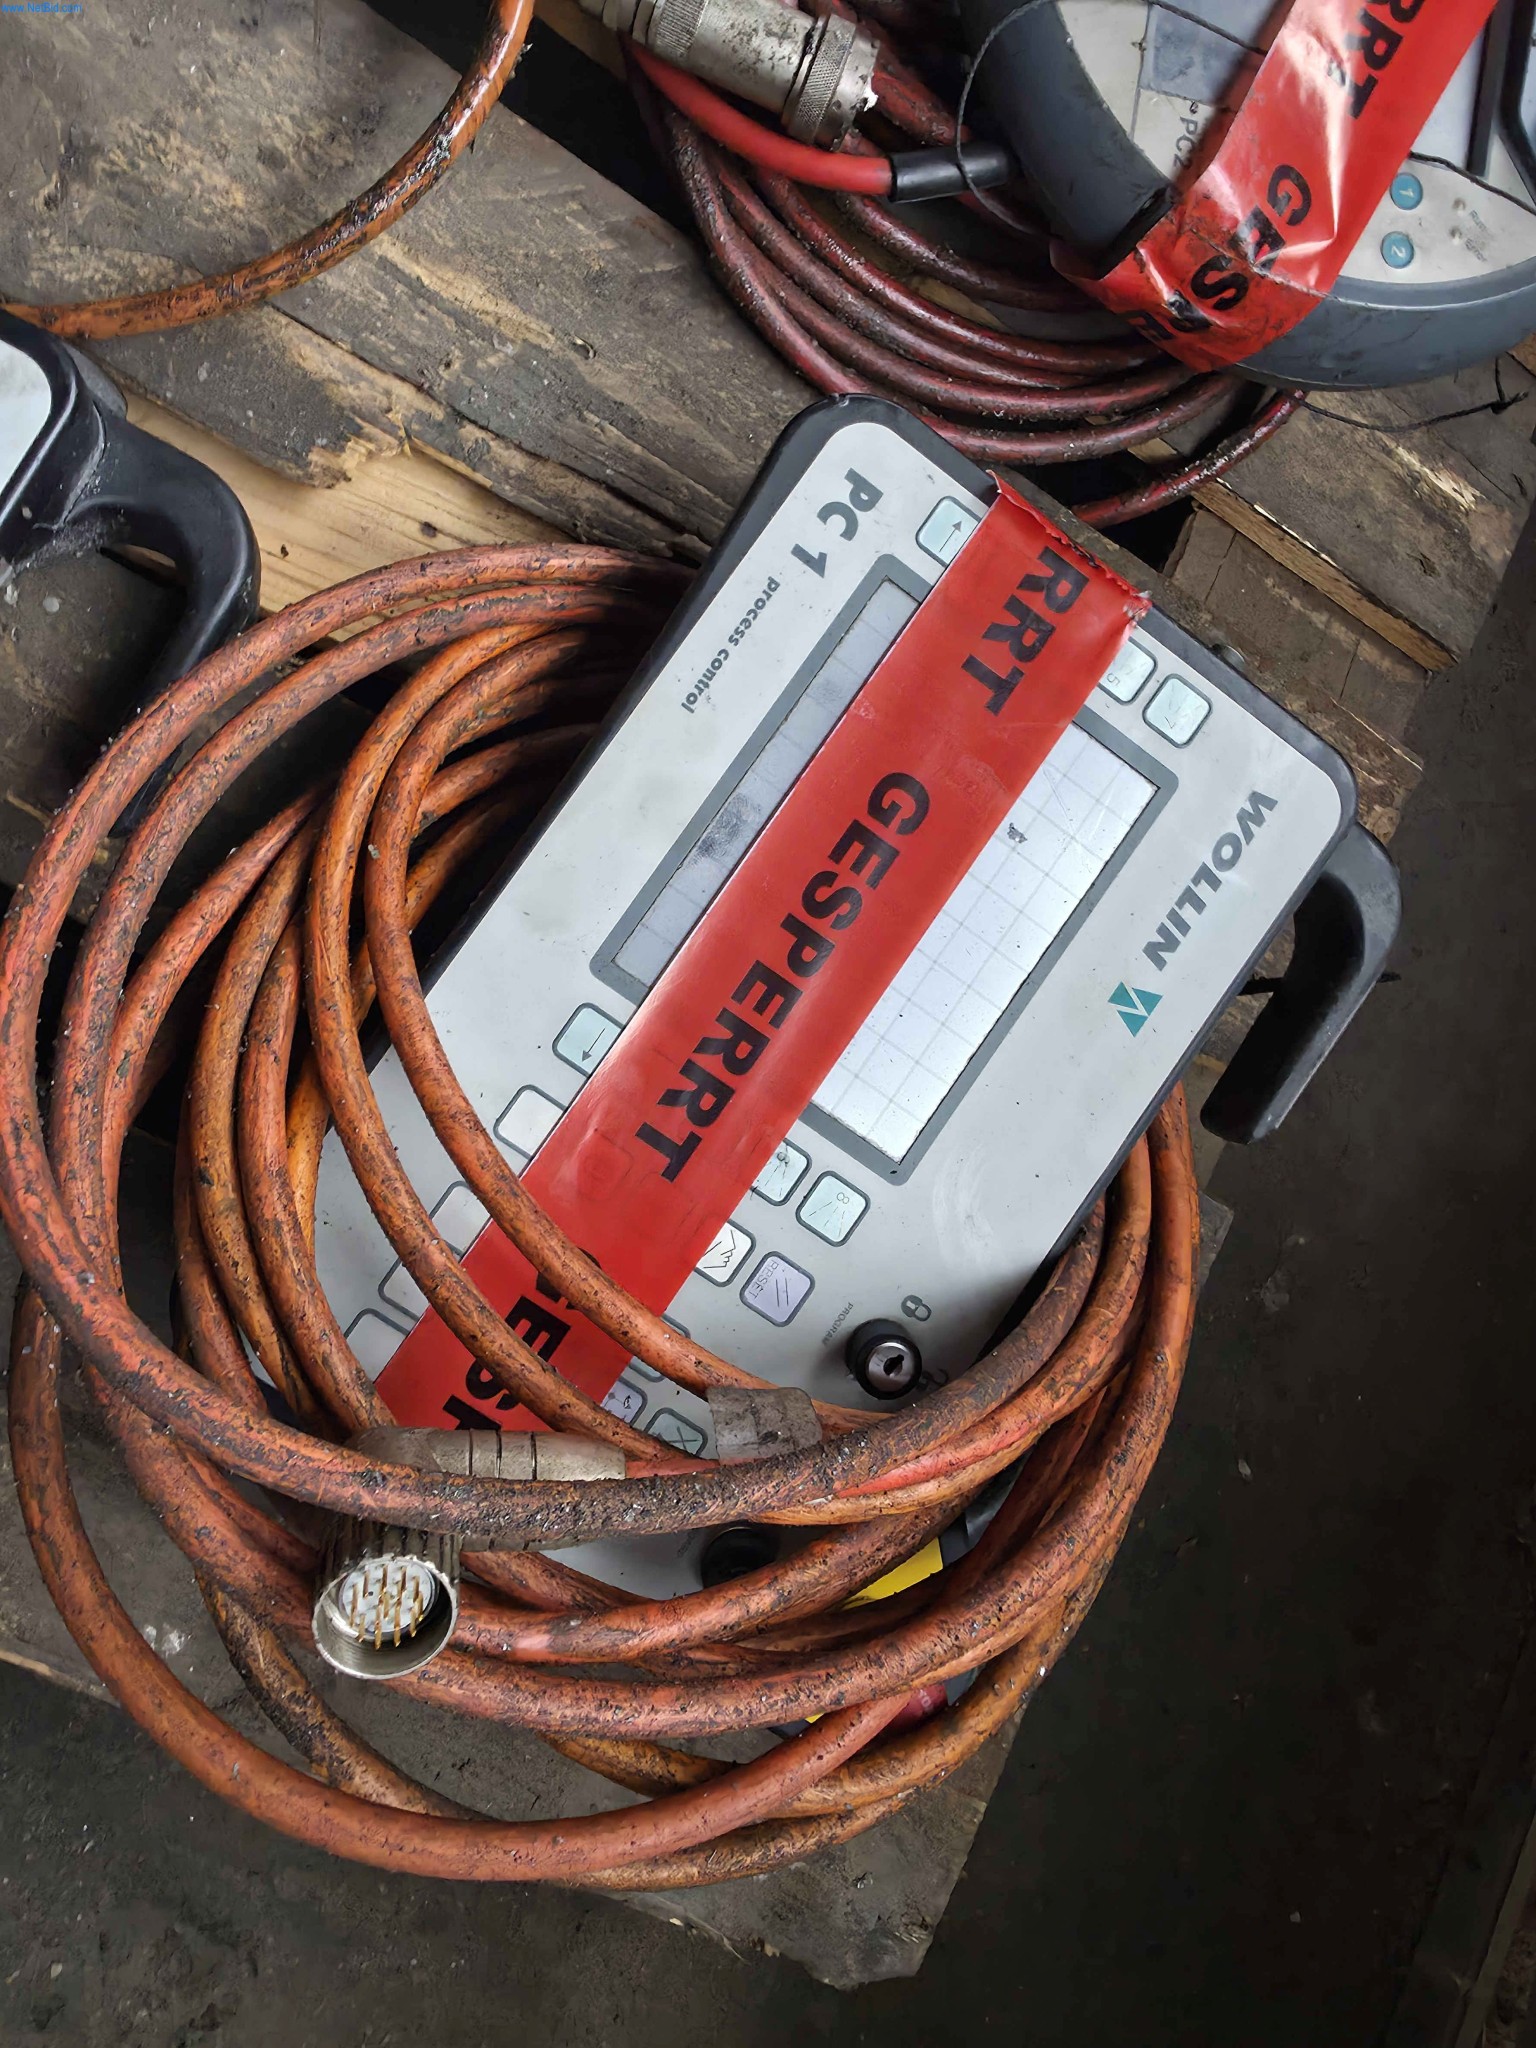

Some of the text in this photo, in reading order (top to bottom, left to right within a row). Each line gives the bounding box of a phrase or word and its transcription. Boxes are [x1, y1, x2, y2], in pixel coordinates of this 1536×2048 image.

[1399, 188, 1415, 199] 1
[1391, 245, 1407, 258] 2
[790, 467, 884, 579] PC 1
[681, 576, 781, 714] process control
[1142, 790, 1279, 972] WOLLIN
[634, 772, 931, 1183] GESPERRT
[749, 1260, 780, 1299] RESET
[822, 1302, 854, 1346] PROGRAM
